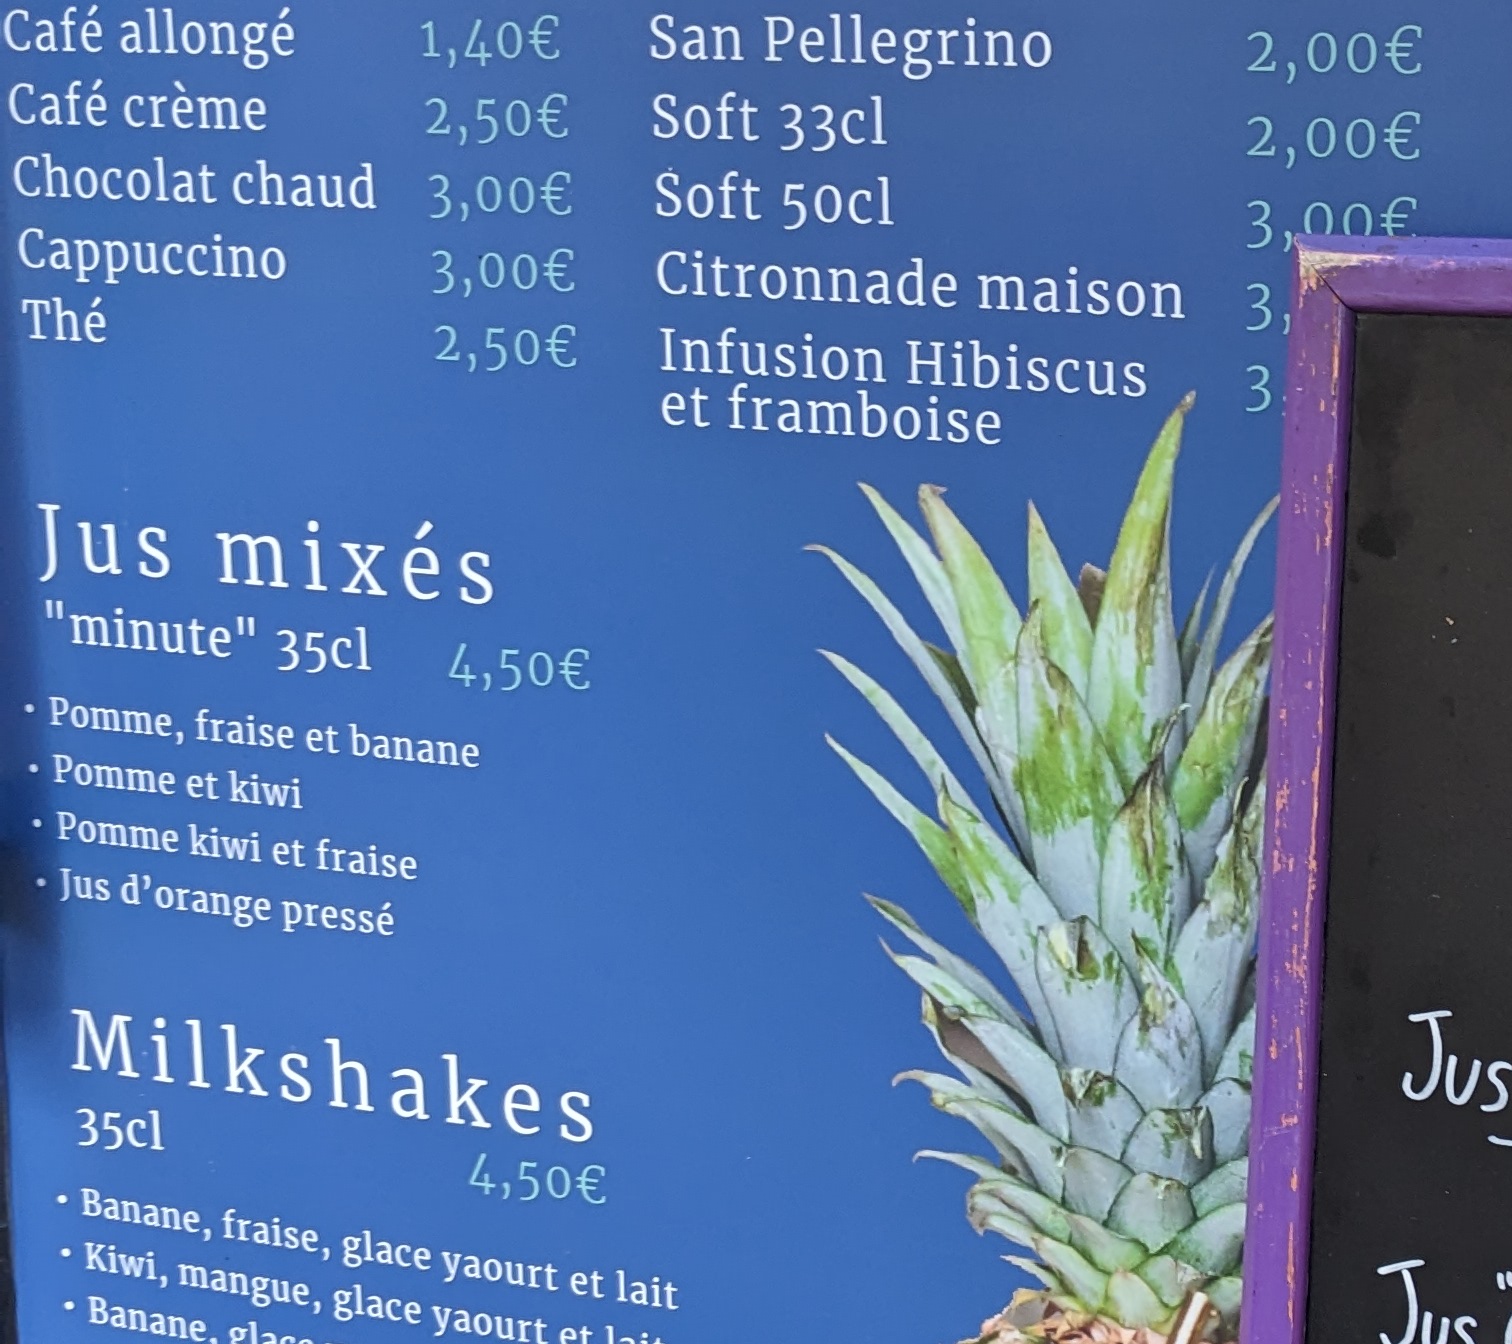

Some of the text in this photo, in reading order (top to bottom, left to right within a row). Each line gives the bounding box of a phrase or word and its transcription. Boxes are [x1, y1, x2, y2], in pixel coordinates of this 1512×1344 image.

[3, 4, 295, 70] Café allongé
[420, 14, 560, 69] 1,40€
[650, 13, 1052, 80] San Pellegrino
[1247, 24, 1422, 85] 2,00€
[8, 78, 267, 131] Café crème
[425, 93, 569, 146] 2,50€
[653, 91, 888, 152] Soft 33cl
[1246, 111, 1421, 169] 2,00€
[13, 152, 377, 209] Chocolat chaud
[428, 170, 572, 222] 3,00€
[655, 170, 895, 230] Soft 50cl
[18, 227, 286, 285] Cappuccino
[431, 248, 575, 298] 3,00€
[656, 250, 1186, 319] Citronnade maison
[21, 296, 107, 343] Thé
[434, 324, 577, 373] 2,50€
[659, 326, 1147, 397] Infusion Hibiscus
[661, 382, 1001, 445] et framboise
[37, 503, 493, 605] Jus mixés
[45, 599, 372, 674] "minute" 35cl
[448, 642, 591, 692] 4,50€
[48, 696, 480, 768] Pomme, fraise et banane
[52, 754, 304, 809] Pomme et kiwi
[56, 811, 418, 880] Pomme kiwi et fraise
[59, 867, 394, 936] Jus d’orange pressé
[69, 1008, 596, 1144] Milkshakes
[76, 1108, 165, 1151] 35cl
[469, 1152, 607, 1205] 4,50€
[80, 1187, 679, 1310] Banane, fraise, glace yaourt et lait
[84, 1241, 168, 1289] Kiwi,
[177, 1263, 321, 1315] mangue,
[333, 1284, 422, 1325] glace
